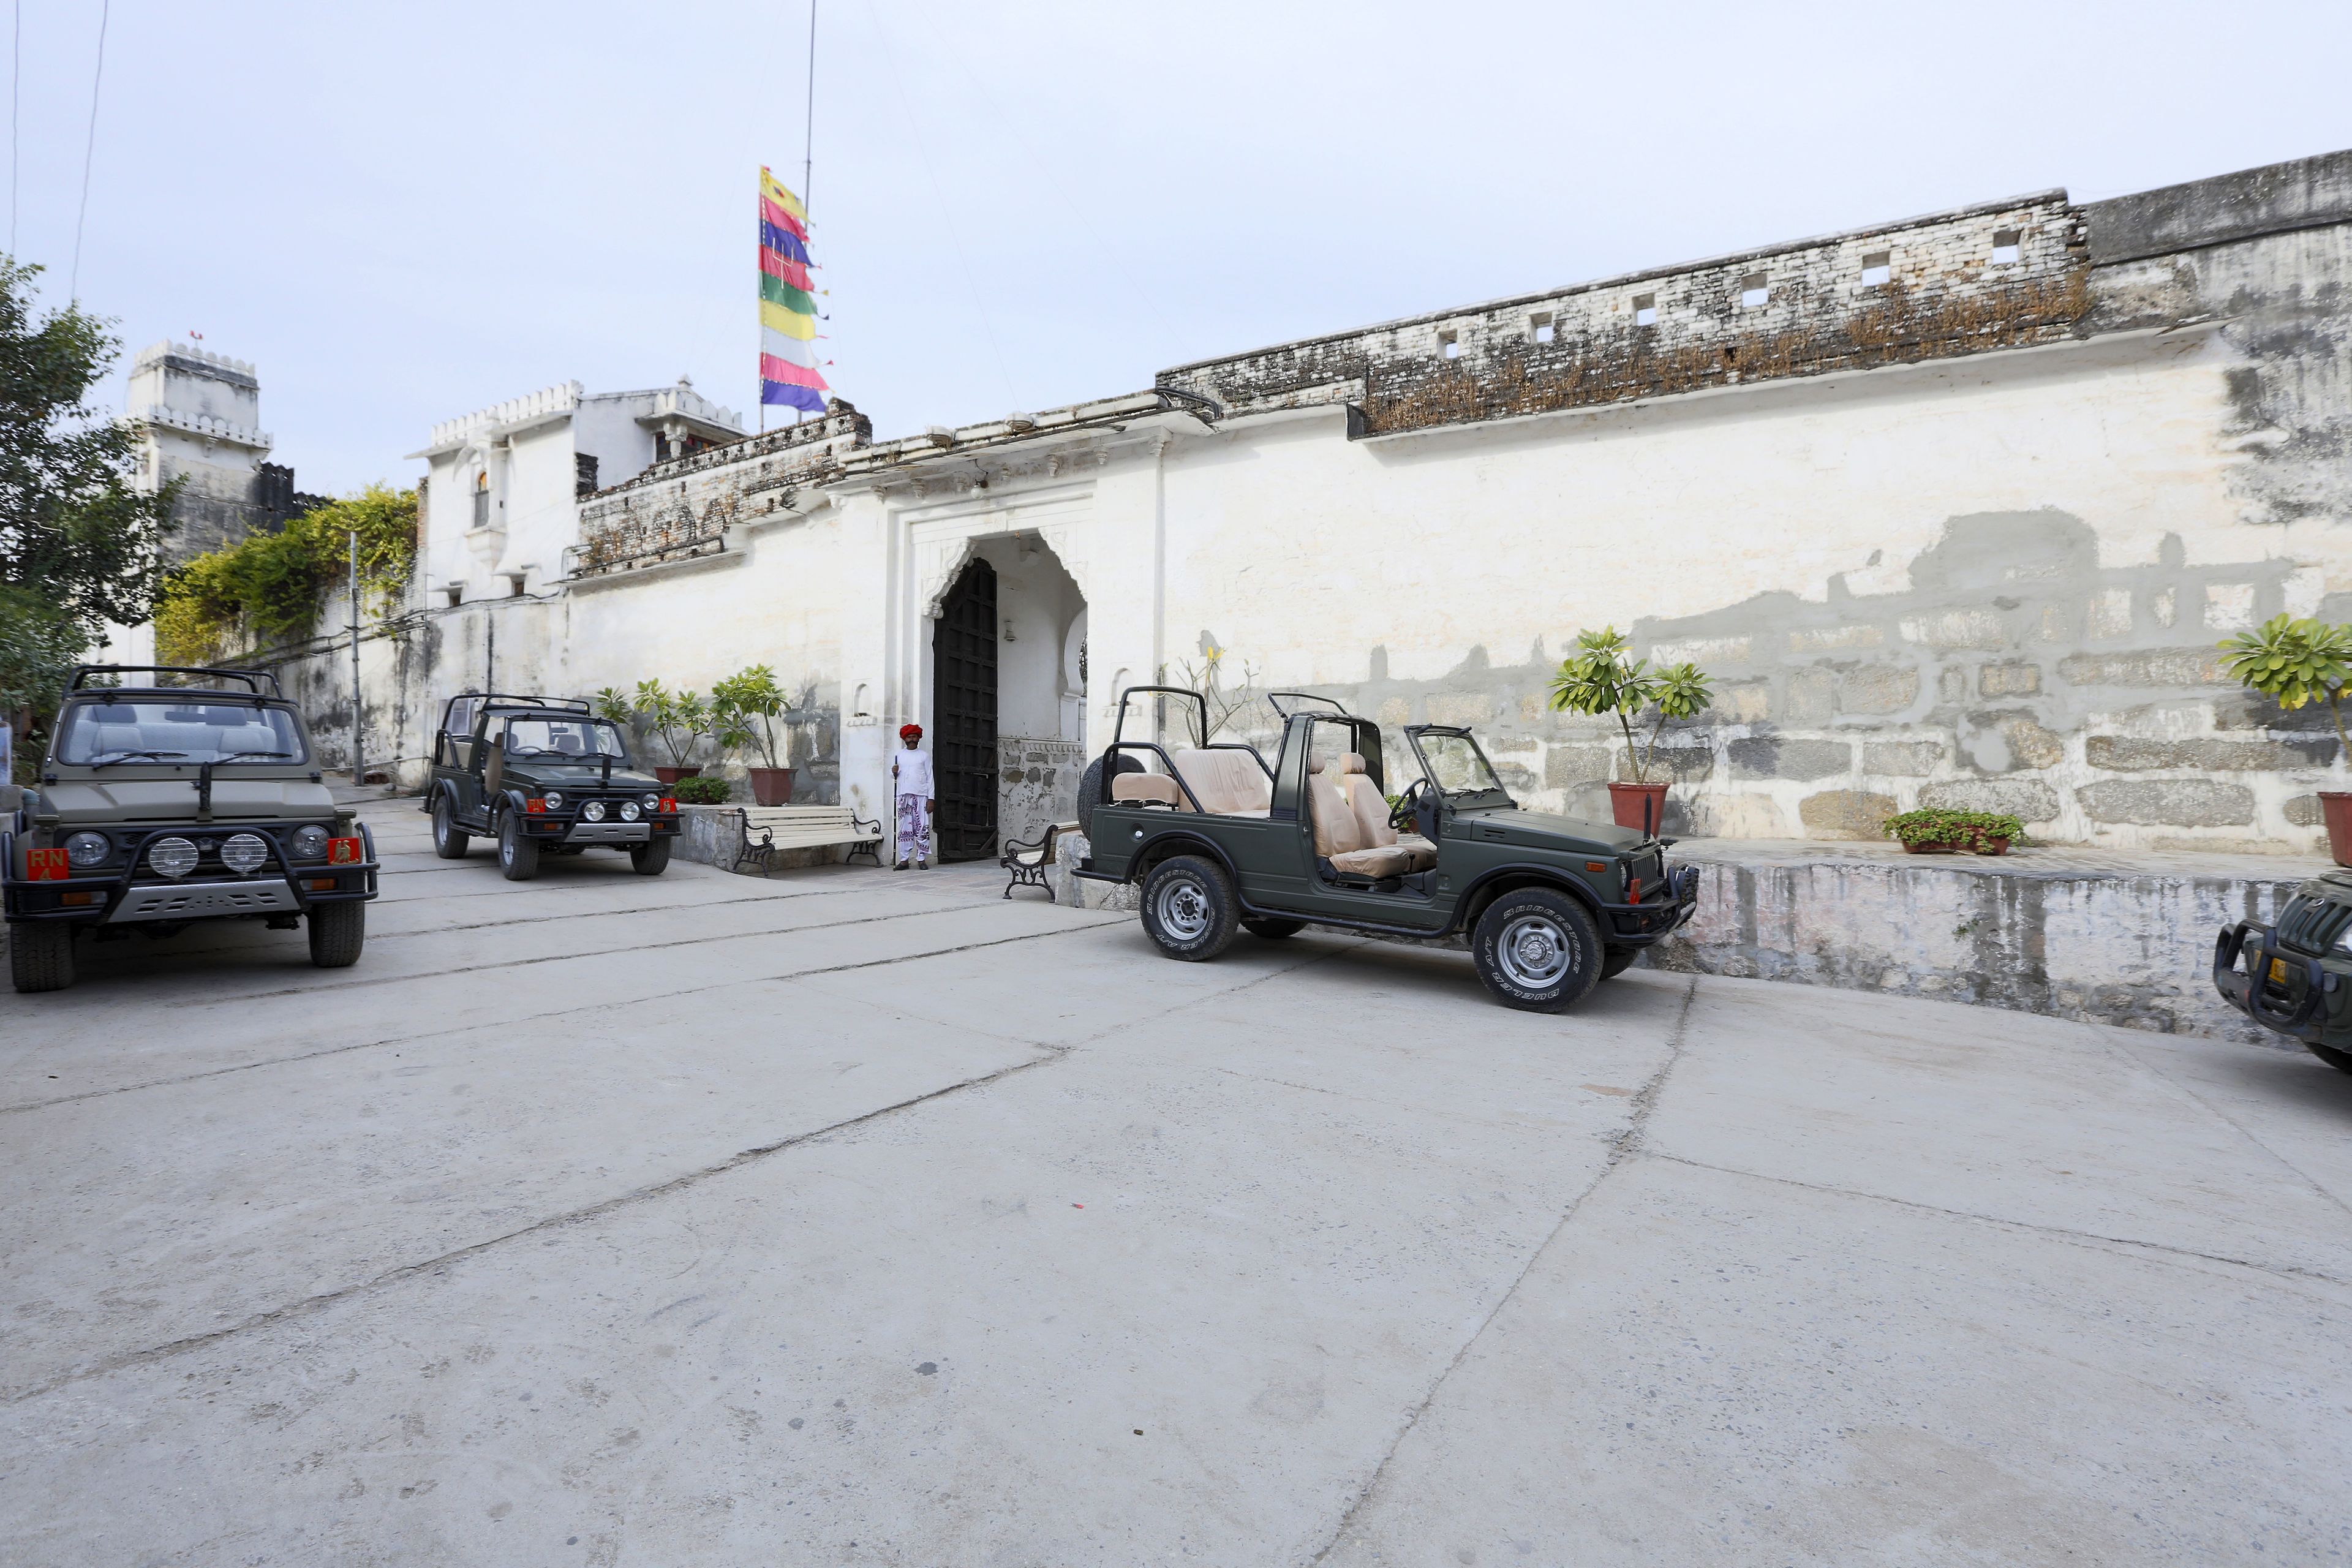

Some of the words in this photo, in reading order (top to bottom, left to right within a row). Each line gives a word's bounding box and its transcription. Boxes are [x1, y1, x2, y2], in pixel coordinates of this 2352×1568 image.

[31, 851, 64, 867] RN
[39, 868, 53, 880] 4
[1147, 870, 1207, 915] BRIDGESTONE
[1156, 934, 1177, 948] A/T
[1181, 907, 1215, 950] DUELER
[1504, 905, 1581, 974] BRIDGESTONE
[1485, 936, 1494, 967] A/T
[1492, 972, 1559, 1000] DUELER
